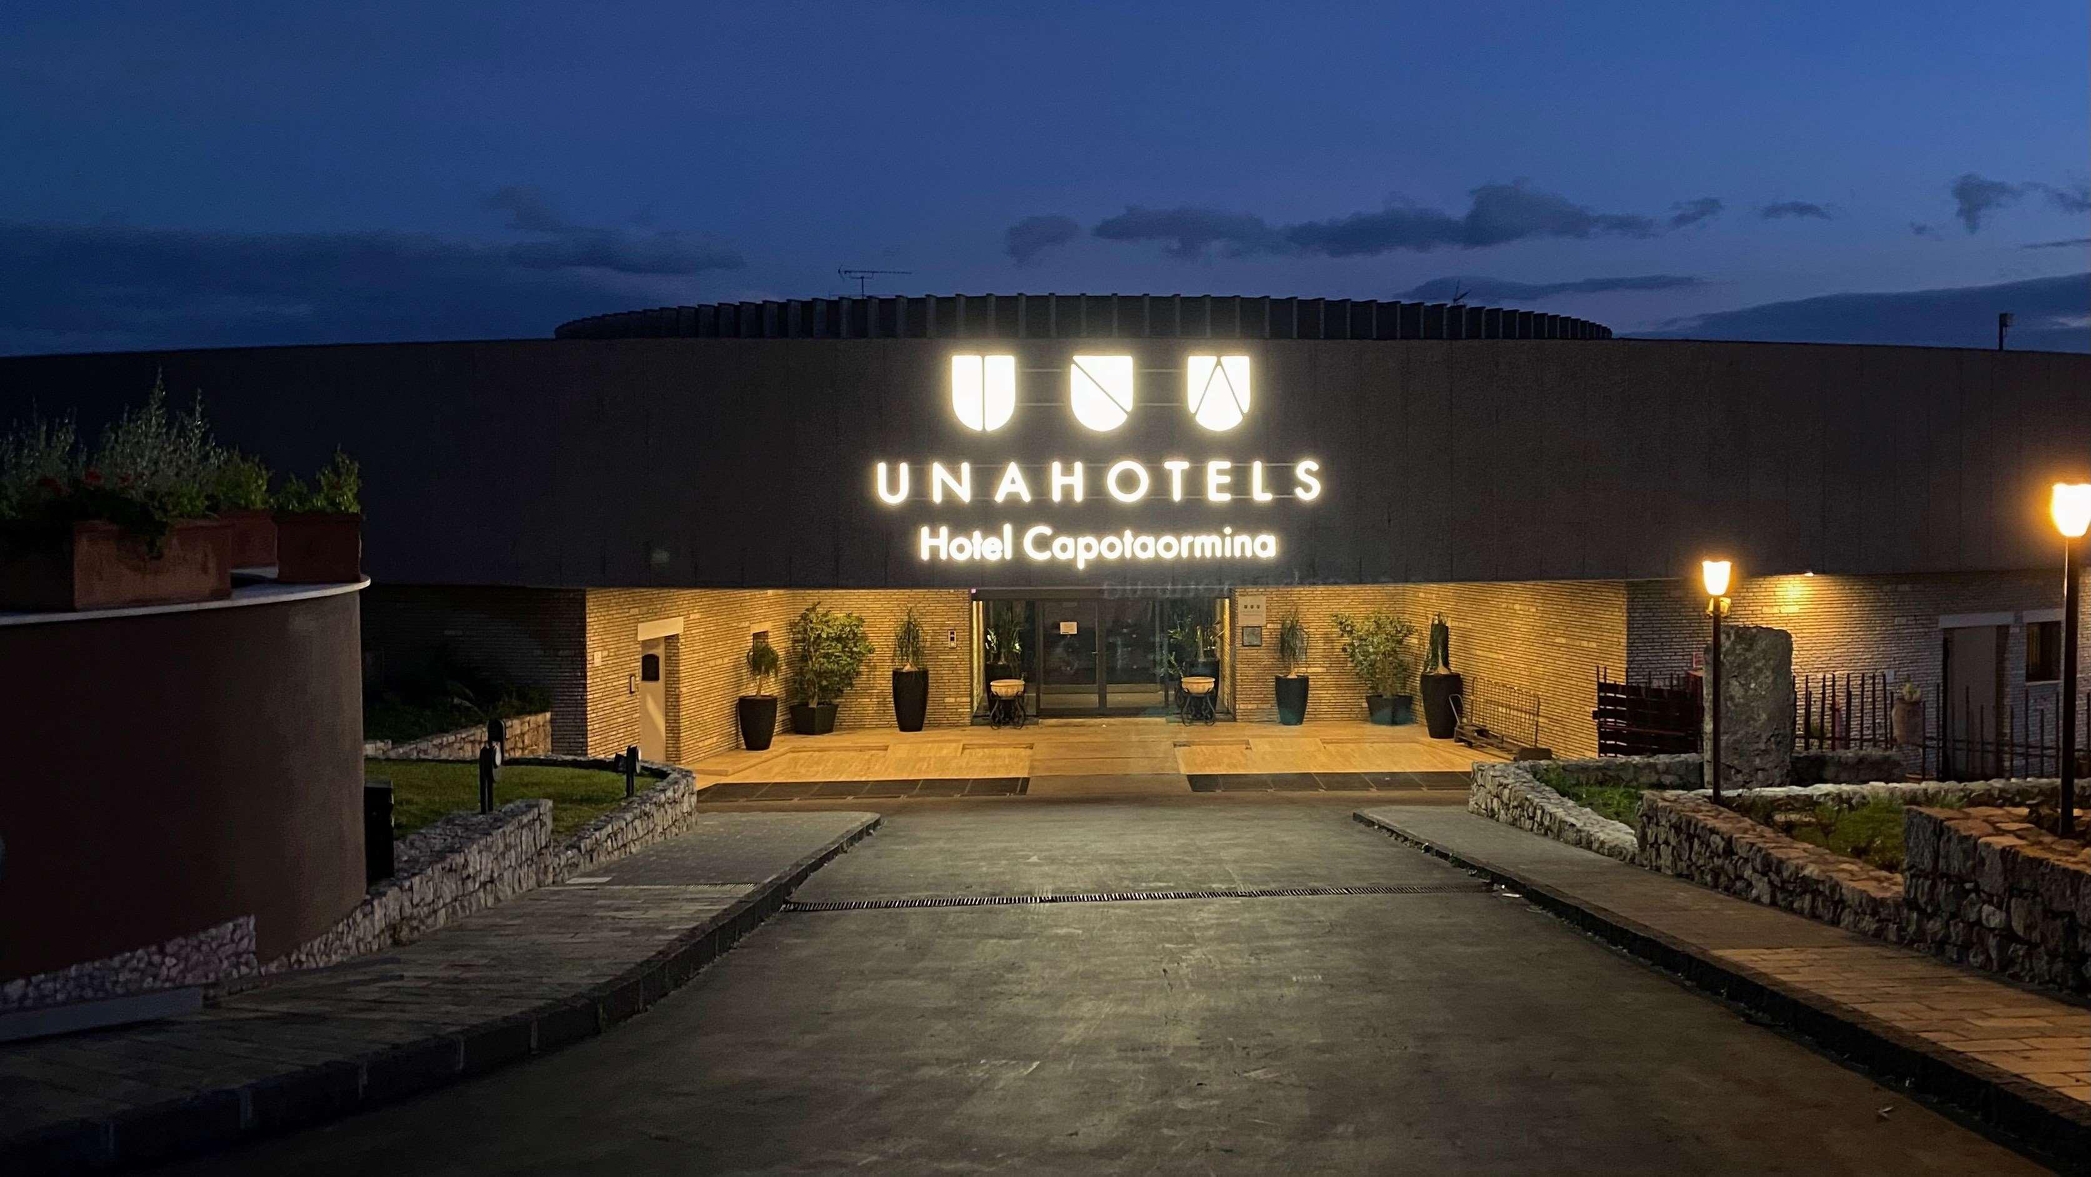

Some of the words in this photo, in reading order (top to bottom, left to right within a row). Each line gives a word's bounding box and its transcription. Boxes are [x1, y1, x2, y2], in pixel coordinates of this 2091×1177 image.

[877, 460, 1321, 504] UNAHOTELS
[920, 523, 1012, 561] Hotel
[1023, 525, 1277, 570] Capotaormina
